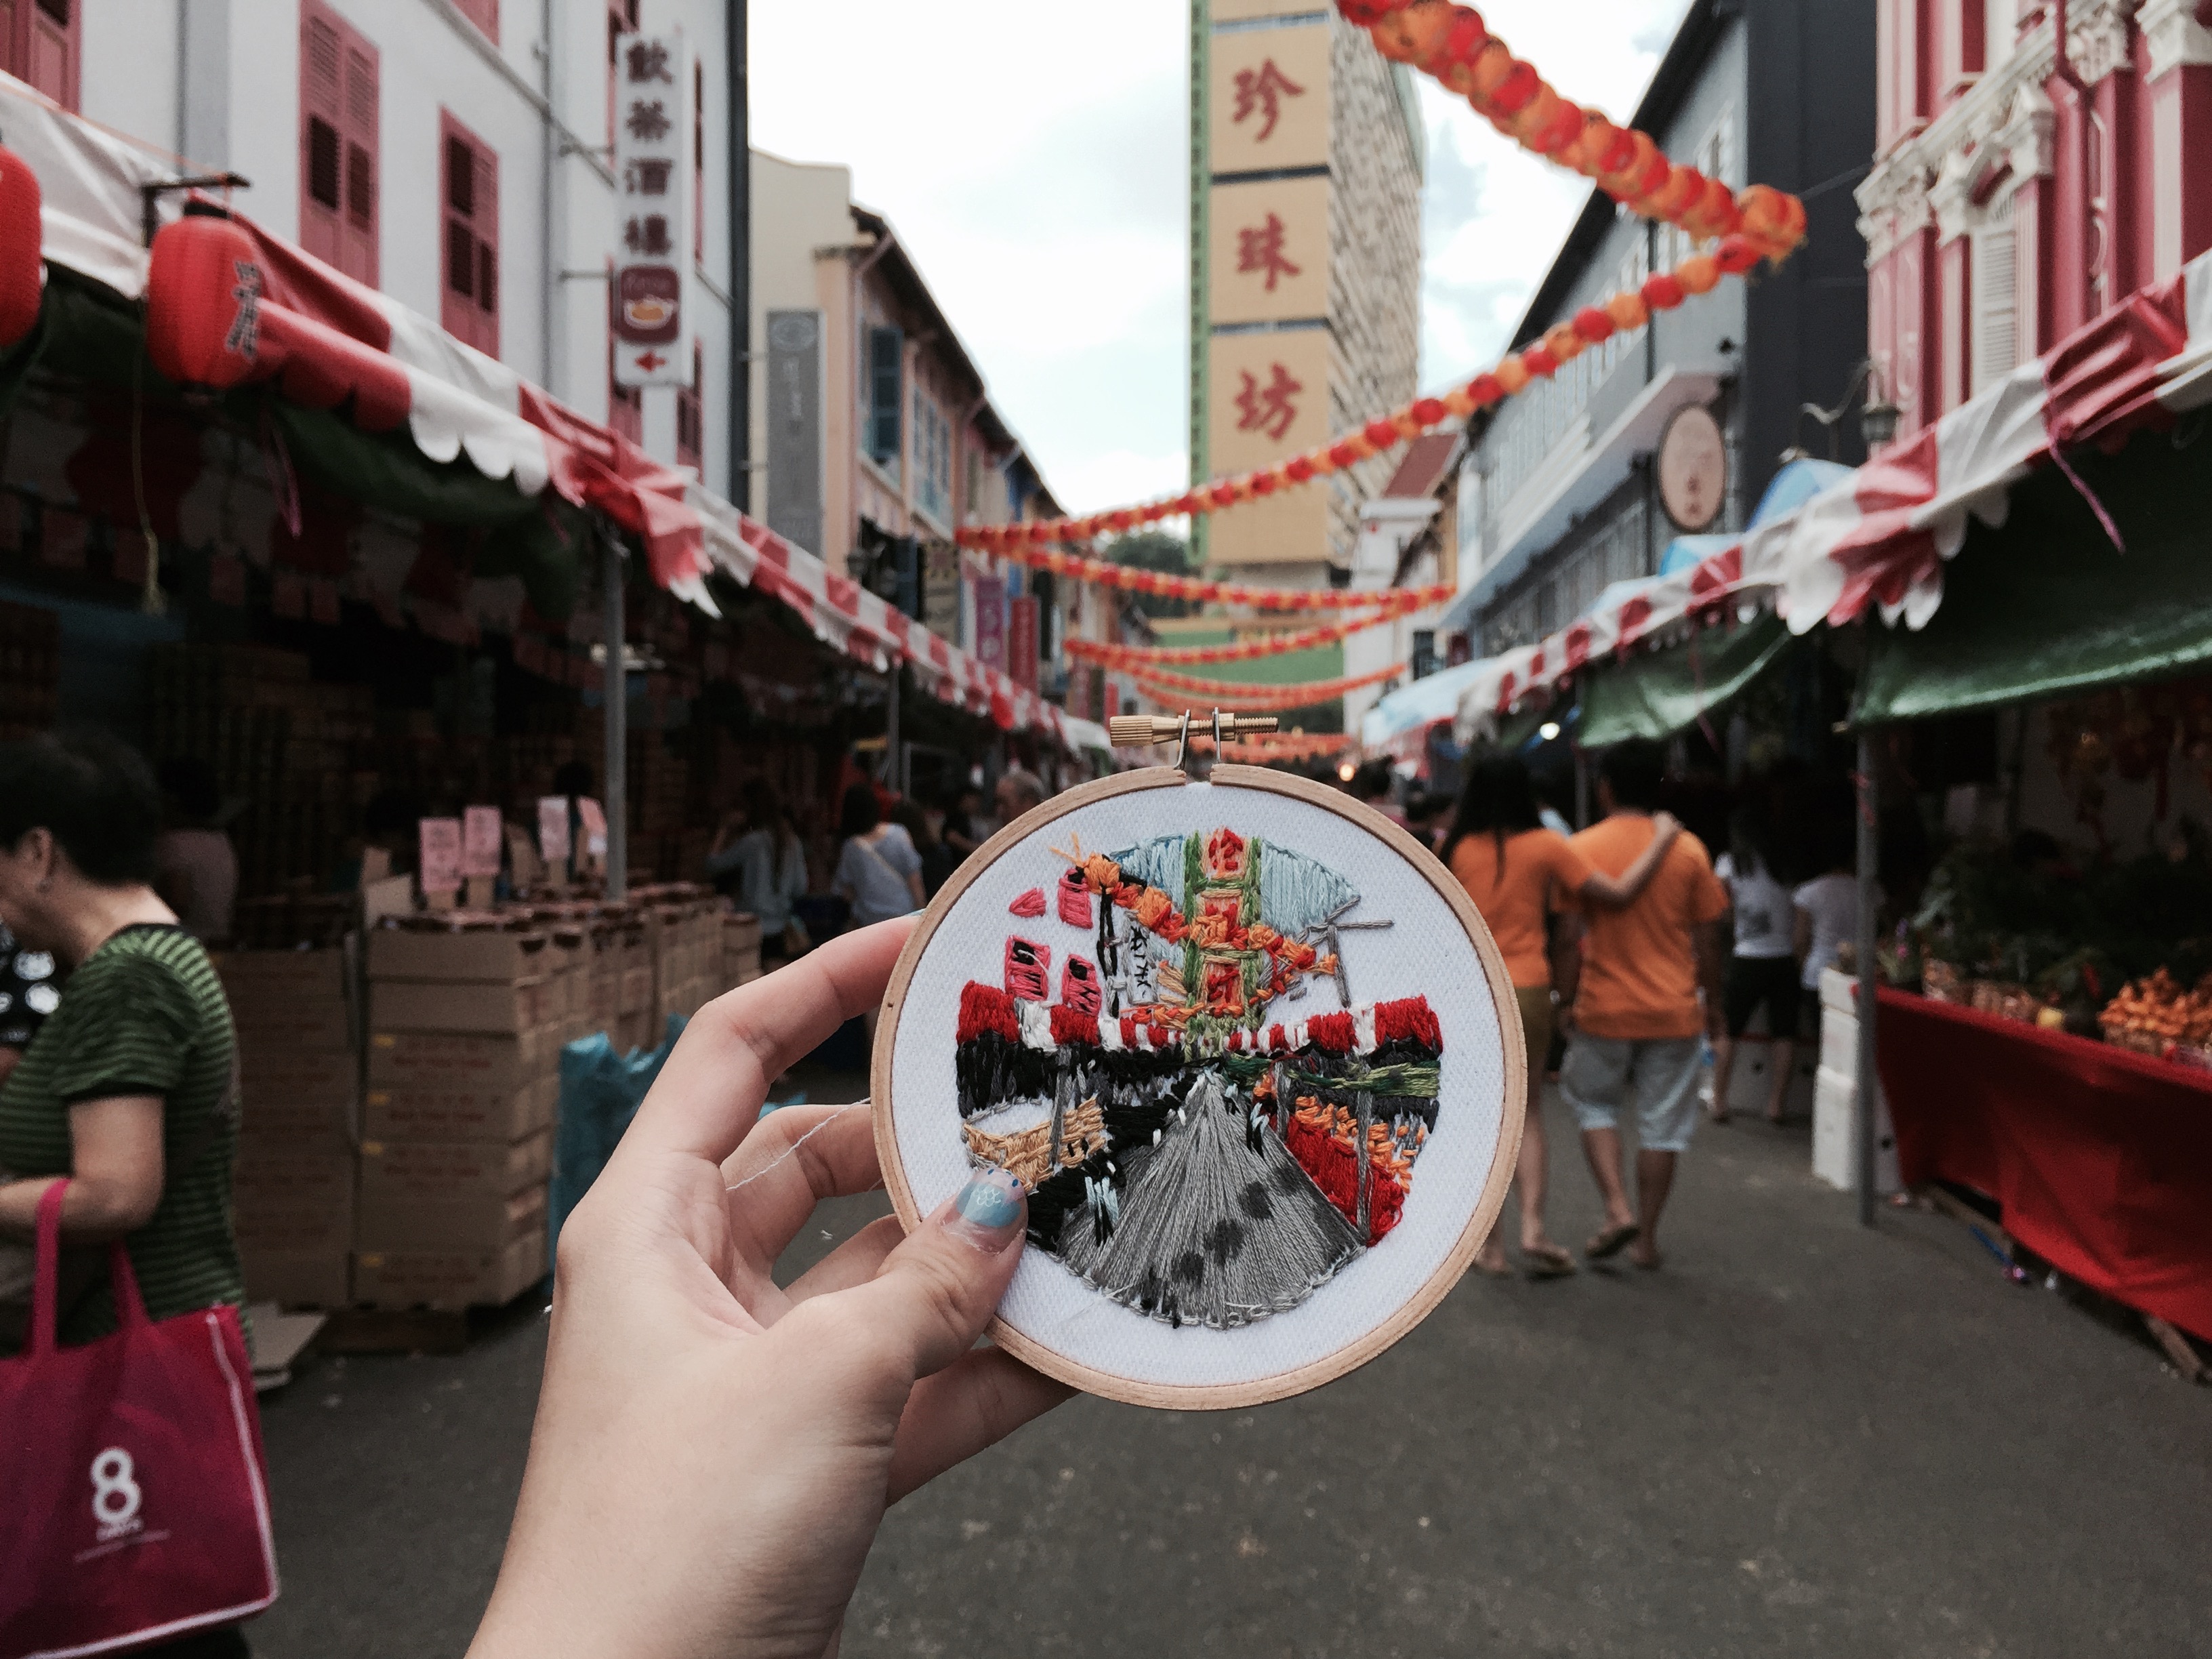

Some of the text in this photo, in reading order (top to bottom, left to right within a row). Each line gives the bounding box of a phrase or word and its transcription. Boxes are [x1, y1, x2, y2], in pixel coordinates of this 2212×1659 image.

[1232, 58, 1305, 443] 珍珠坊
[90, 1446, 142, 1523] 8
